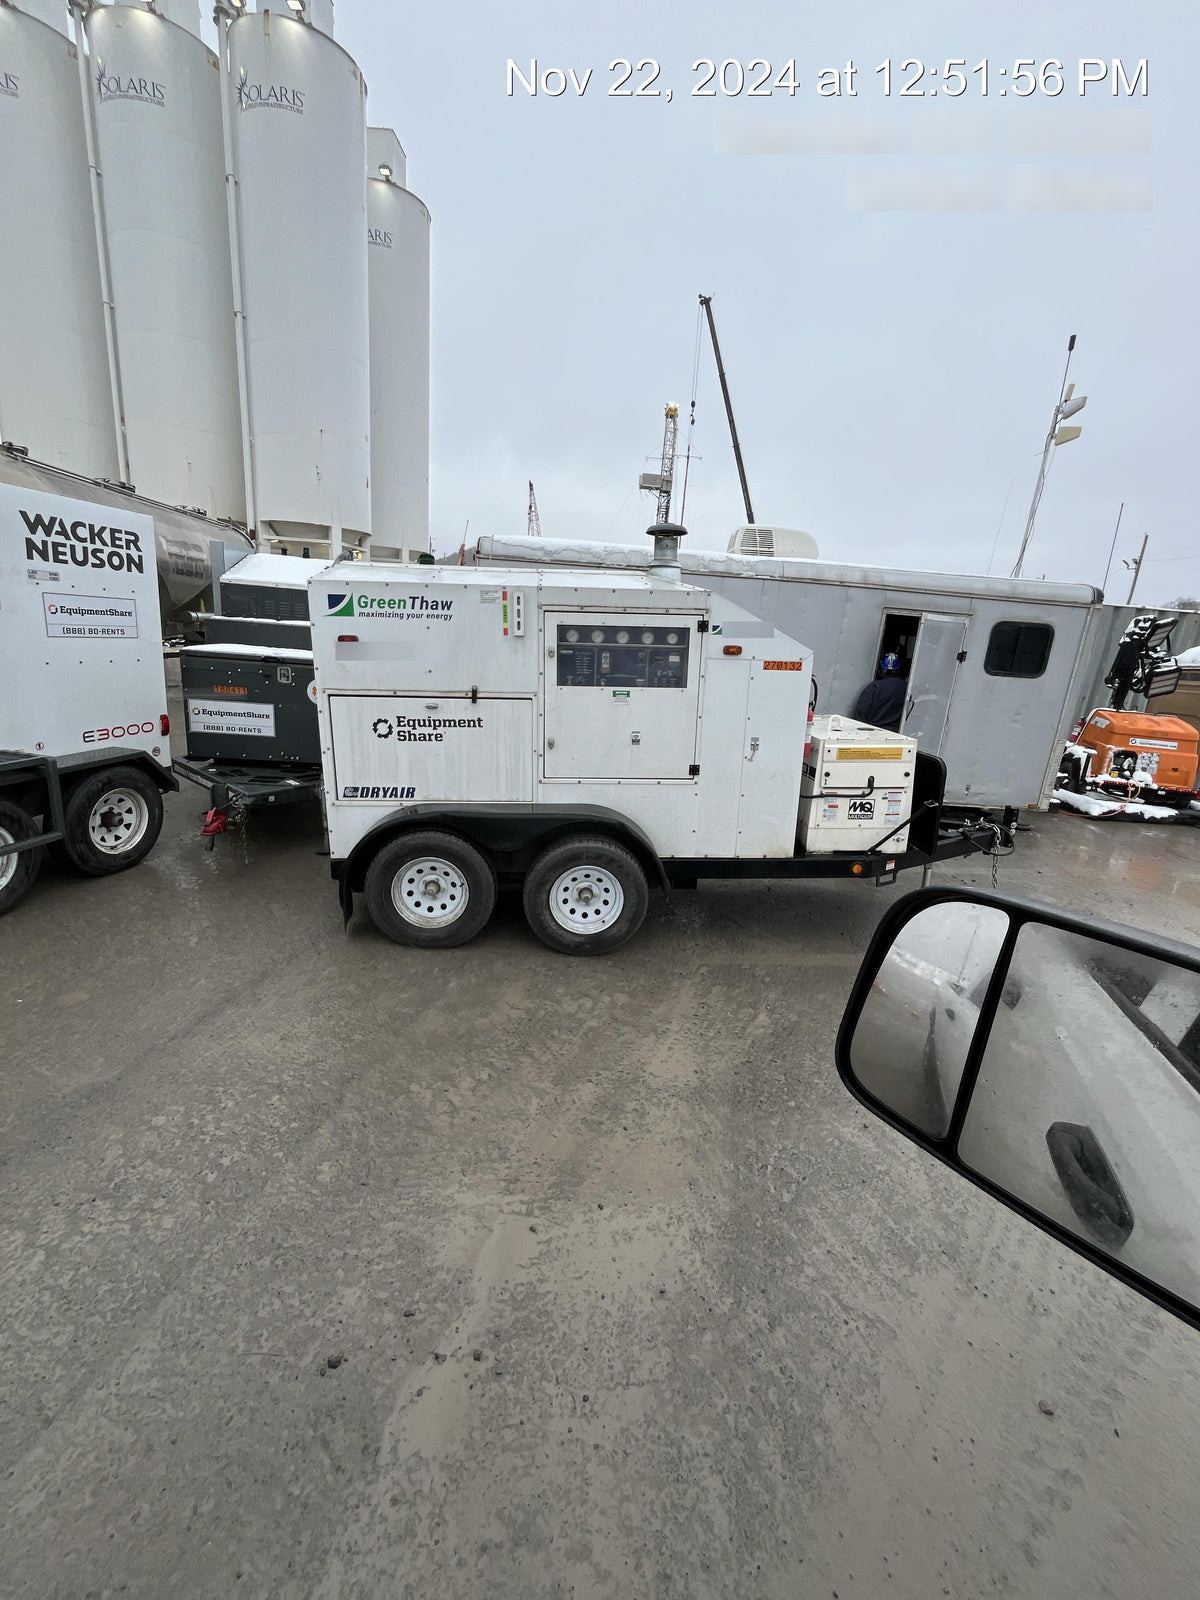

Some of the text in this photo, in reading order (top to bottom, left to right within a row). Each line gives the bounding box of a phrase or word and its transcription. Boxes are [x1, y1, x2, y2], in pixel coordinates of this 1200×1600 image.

[99, 74, 166, 101] SOLARIS
[240, 83, 305, 109] SOLARIS
[19, 509, 144, 552] WACKER
[25, 537, 144, 574] NEUSON
[60, 604, 133, 619] EquipmentShare
[358, 610, 453, 622] maximizing your energy
[62, 626, 126, 636] (888) 80-RENTS
[763, 661, 803, 671] 270132
[201, 708, 270, 720] EquipmentShare
[203, 723, 262, 734] (888) 80-RENTS
[396, 715, 483, 731] Equipment
[82, 721, 154, 744] E3000
[396, 729, 444, 742] Share
[359, 786, 416, 799] DRYAIR
[849, 802, 874, 814] MQ
